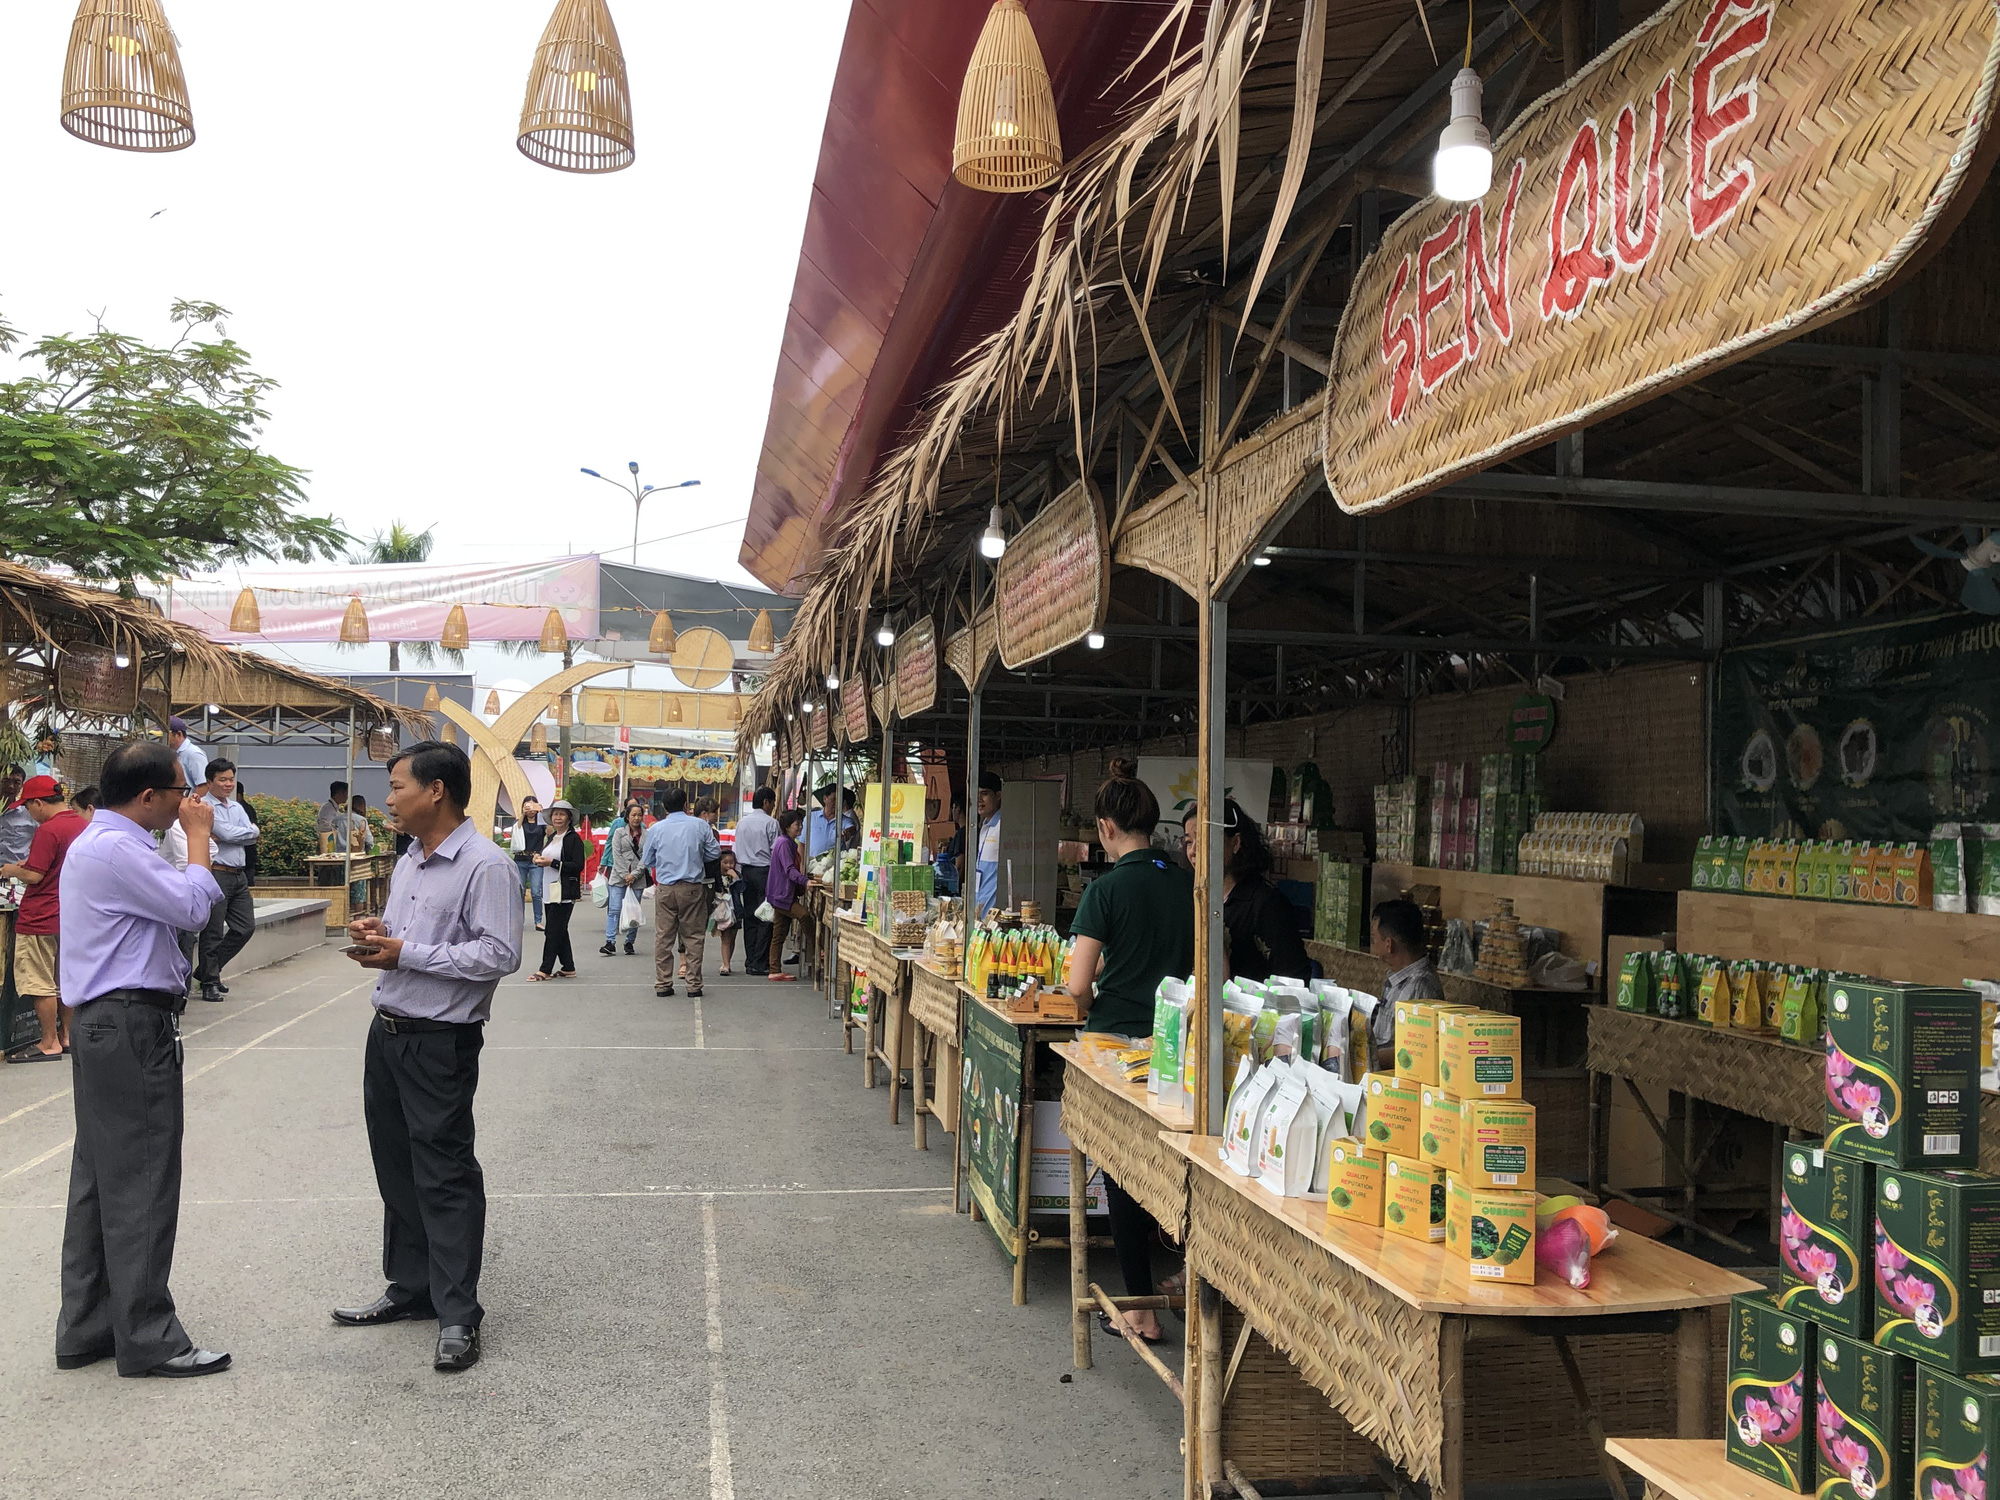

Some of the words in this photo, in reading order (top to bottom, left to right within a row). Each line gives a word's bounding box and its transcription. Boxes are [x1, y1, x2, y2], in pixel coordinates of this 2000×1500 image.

[1382, 157, 1526, 426] SEN
[1540, 0, 1775, 322] QUÊ
[1899, 643, 1919, 666] TY
[1384, 1103, 1407, 1112] QUALITY
[1378, 1111, 1412, 1123] REPUTATION
[1384, 1122, 1405, 1130] NATURE
[1346, 1171, 1369, 1180] QUALITY
[1341, 1178, 1374, 1190] REPUTATION
[1346, 1189, 1367, 1198] NATURE
[1400, 1185, 1419, 1195] QUALITY
[1055, 1197, 1097, 1207] MGO
[1395, 1193, 1424, 1205] REPUTATION
[1400, 1203, 1418, 1213] NATURE
